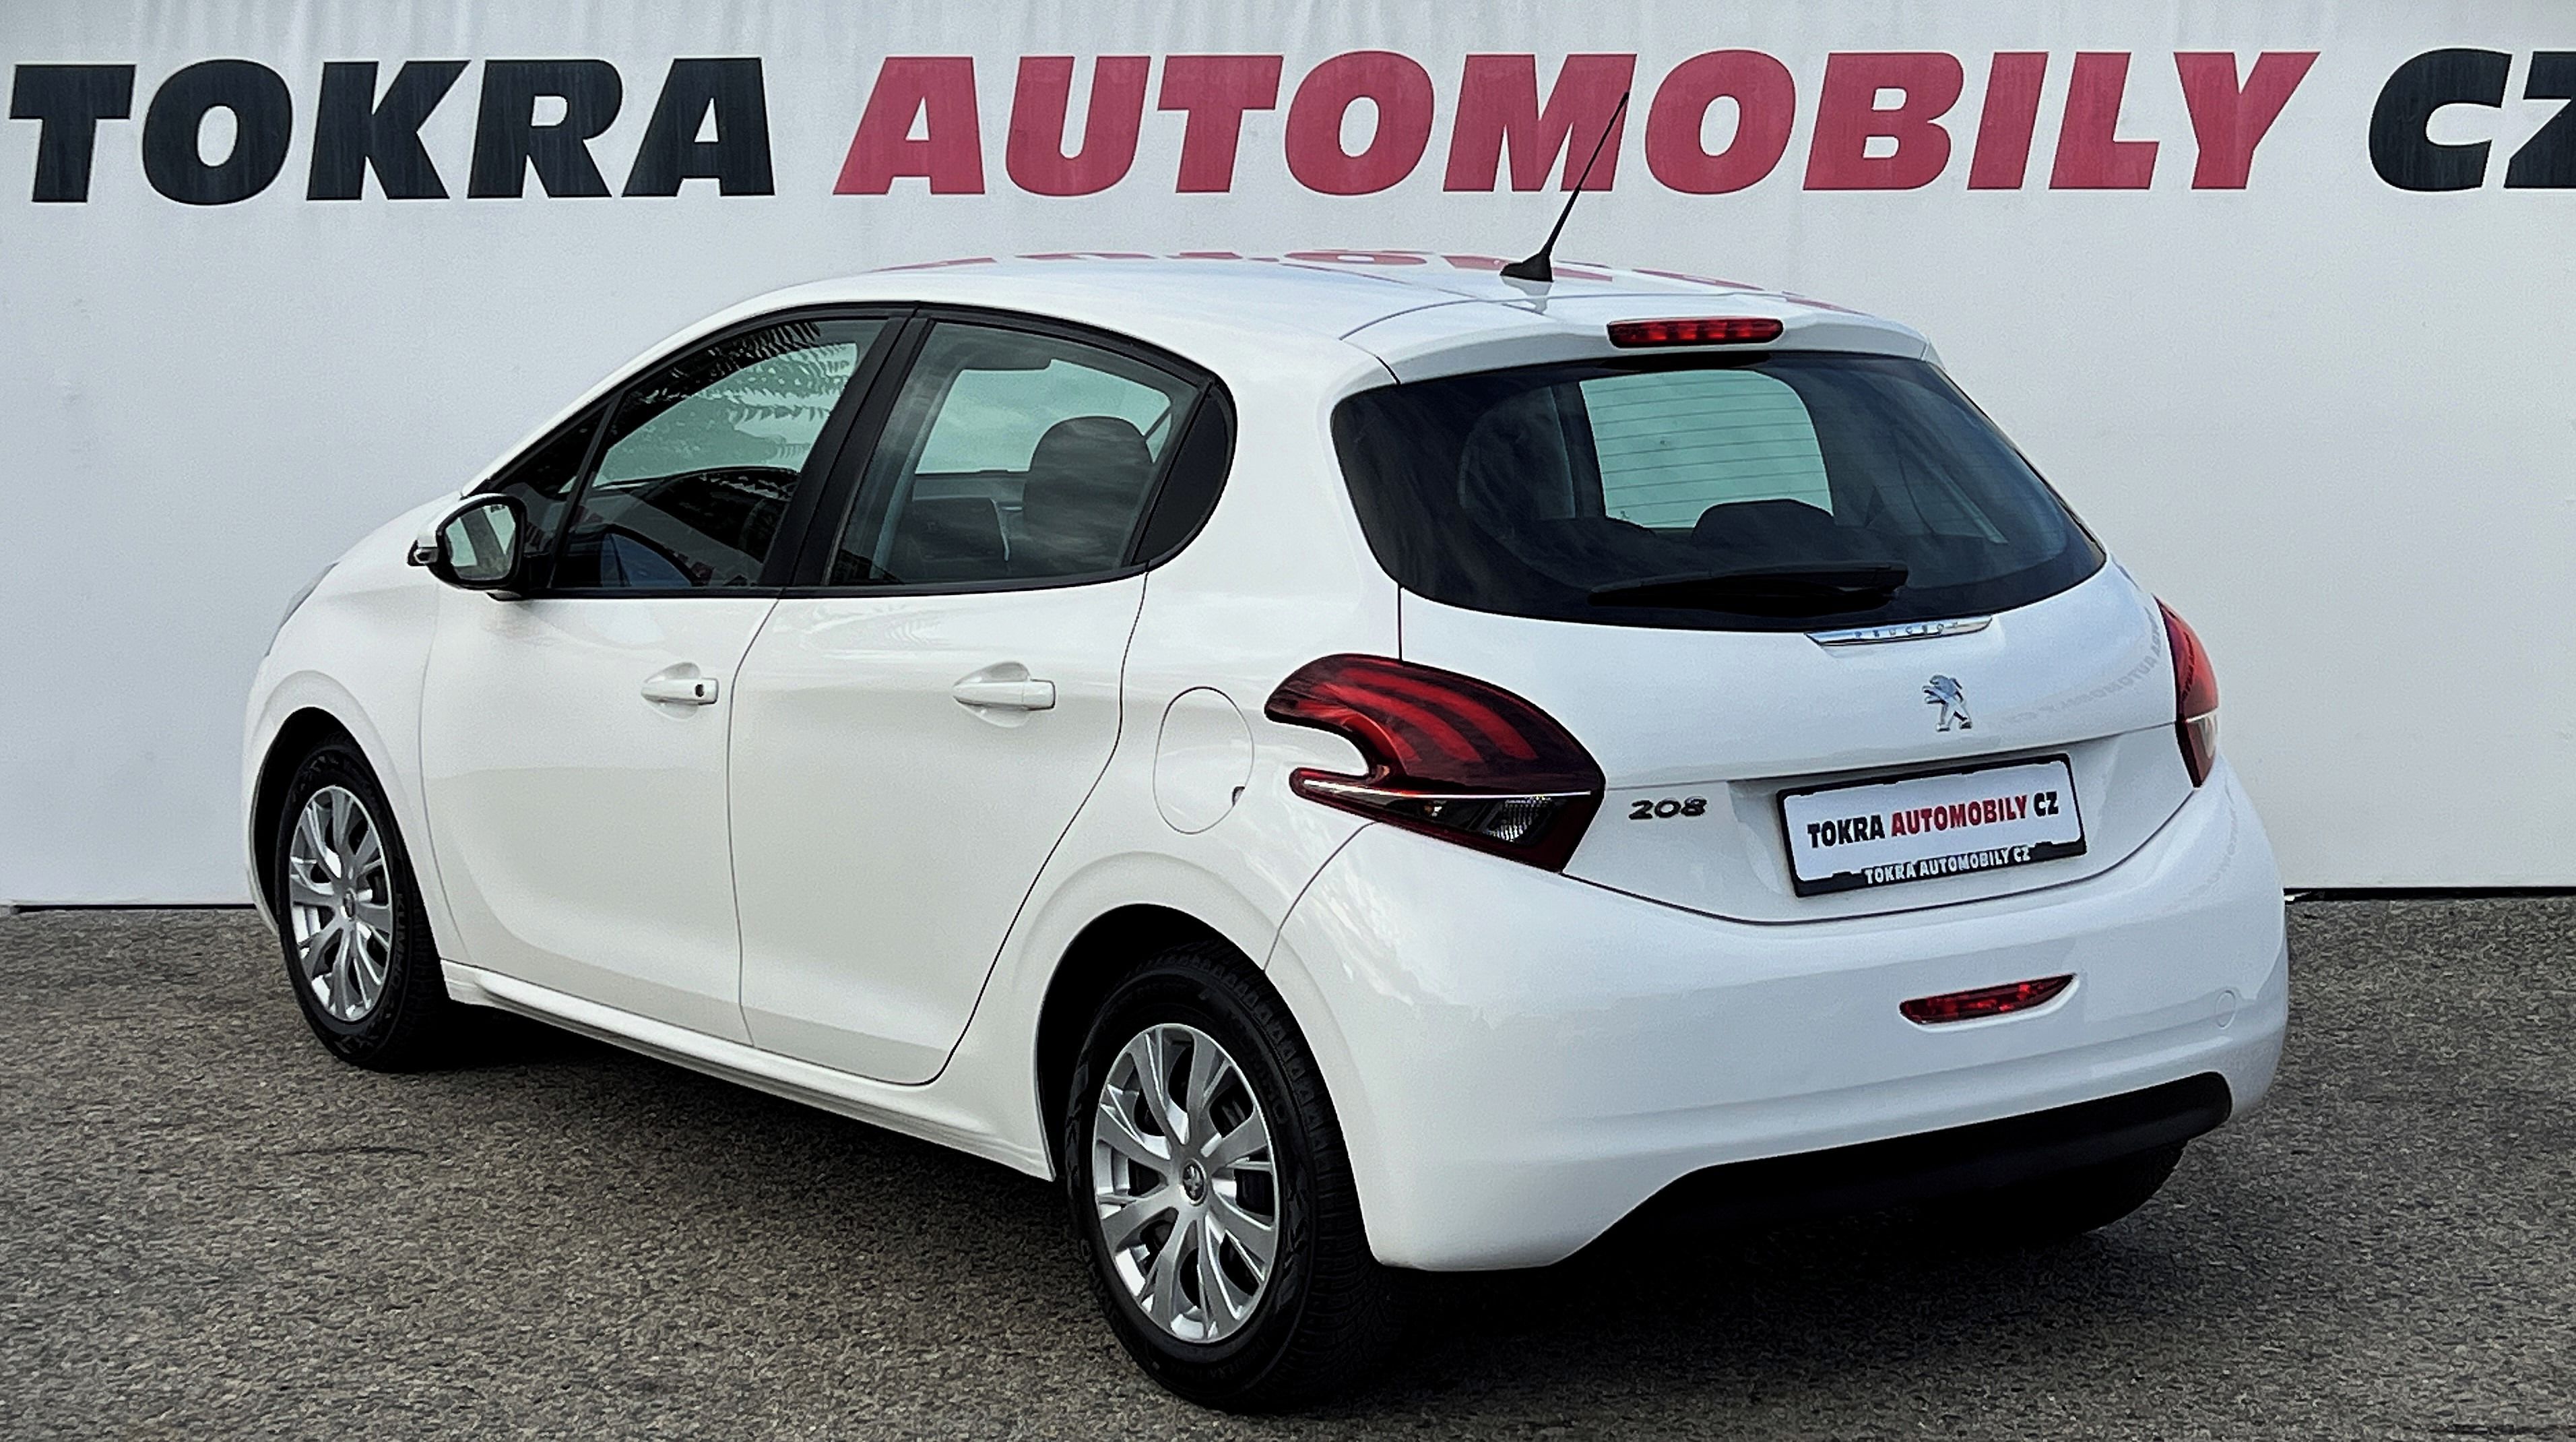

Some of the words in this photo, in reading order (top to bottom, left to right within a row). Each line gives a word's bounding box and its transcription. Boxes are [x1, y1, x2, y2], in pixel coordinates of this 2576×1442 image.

[9, 57, 775, 206] TOKRA
[833, 49, 2321, 196] AUTOMOBILY
[1628, 795, 1708, 821] 208
[1807, 814, 1886, 848] TOKRA
[1891, 794, 2028, 837] AUTOMOBILY
[2033, 790, 2059, 817] CZ
[1864, 862, 1917, 885] TOKRA
[1919, 846, 2010, 876] AUTOMOBILY
[2013, 846, 2031, 862] CZ
